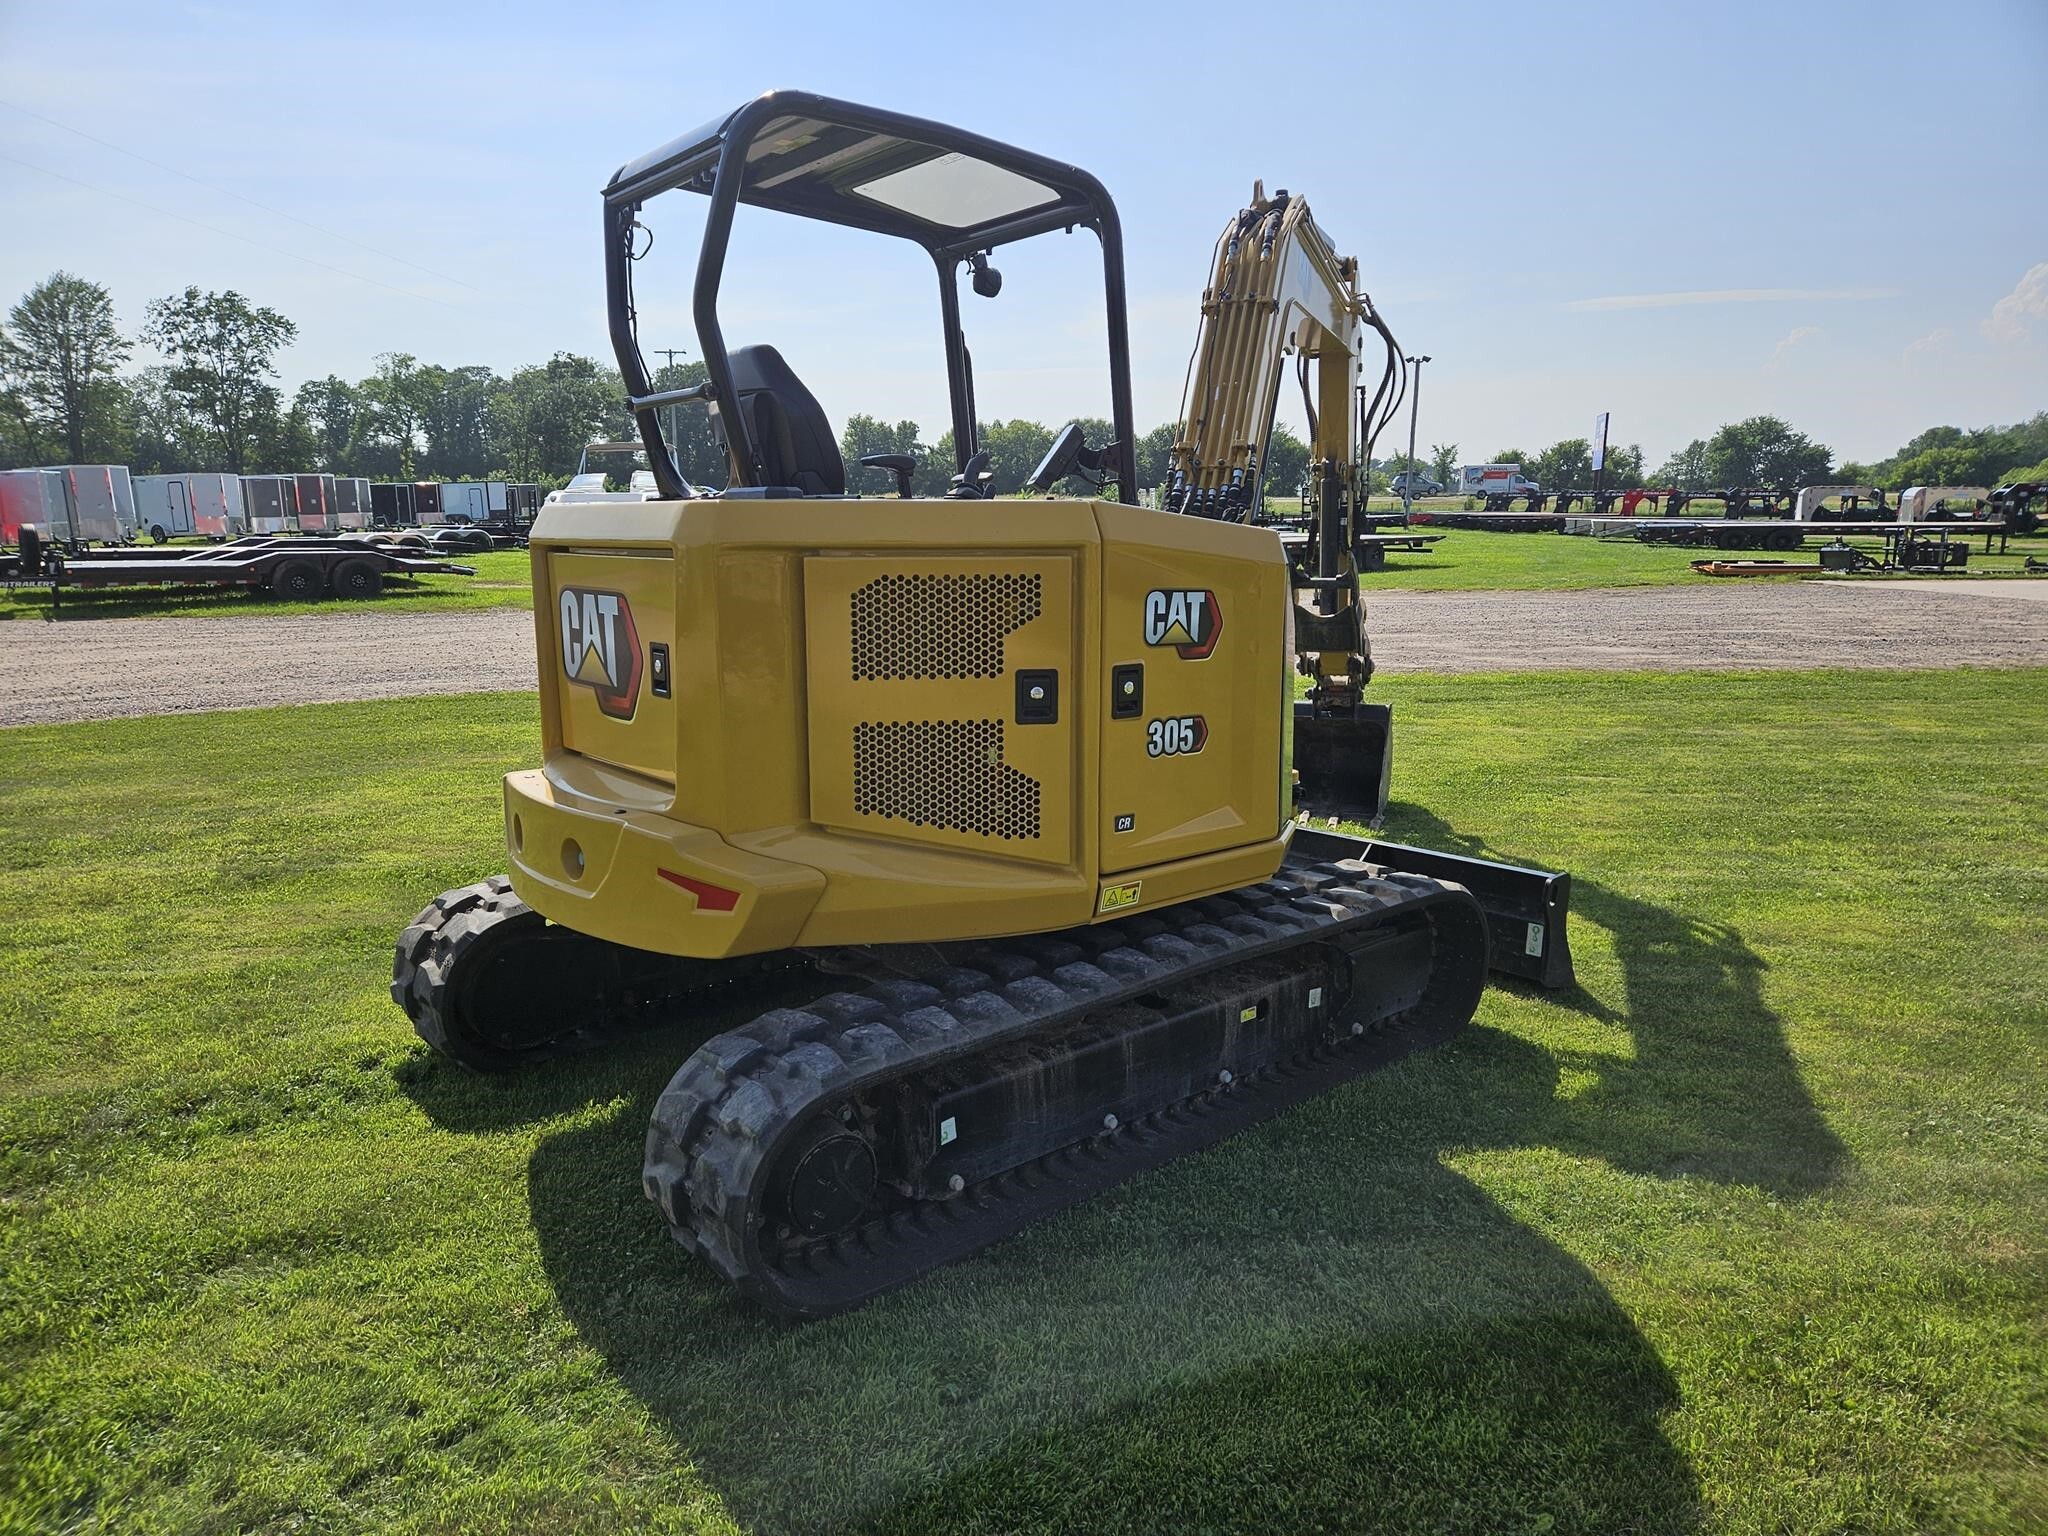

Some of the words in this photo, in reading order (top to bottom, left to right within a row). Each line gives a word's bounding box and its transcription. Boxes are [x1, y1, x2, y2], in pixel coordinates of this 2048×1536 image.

[561, 590, 618, 688] CAT
[1146, 588, 1206, 645] CAT
[1148, 718, 1194, 756] 305
[1118, 817, 1131, 830] CR
